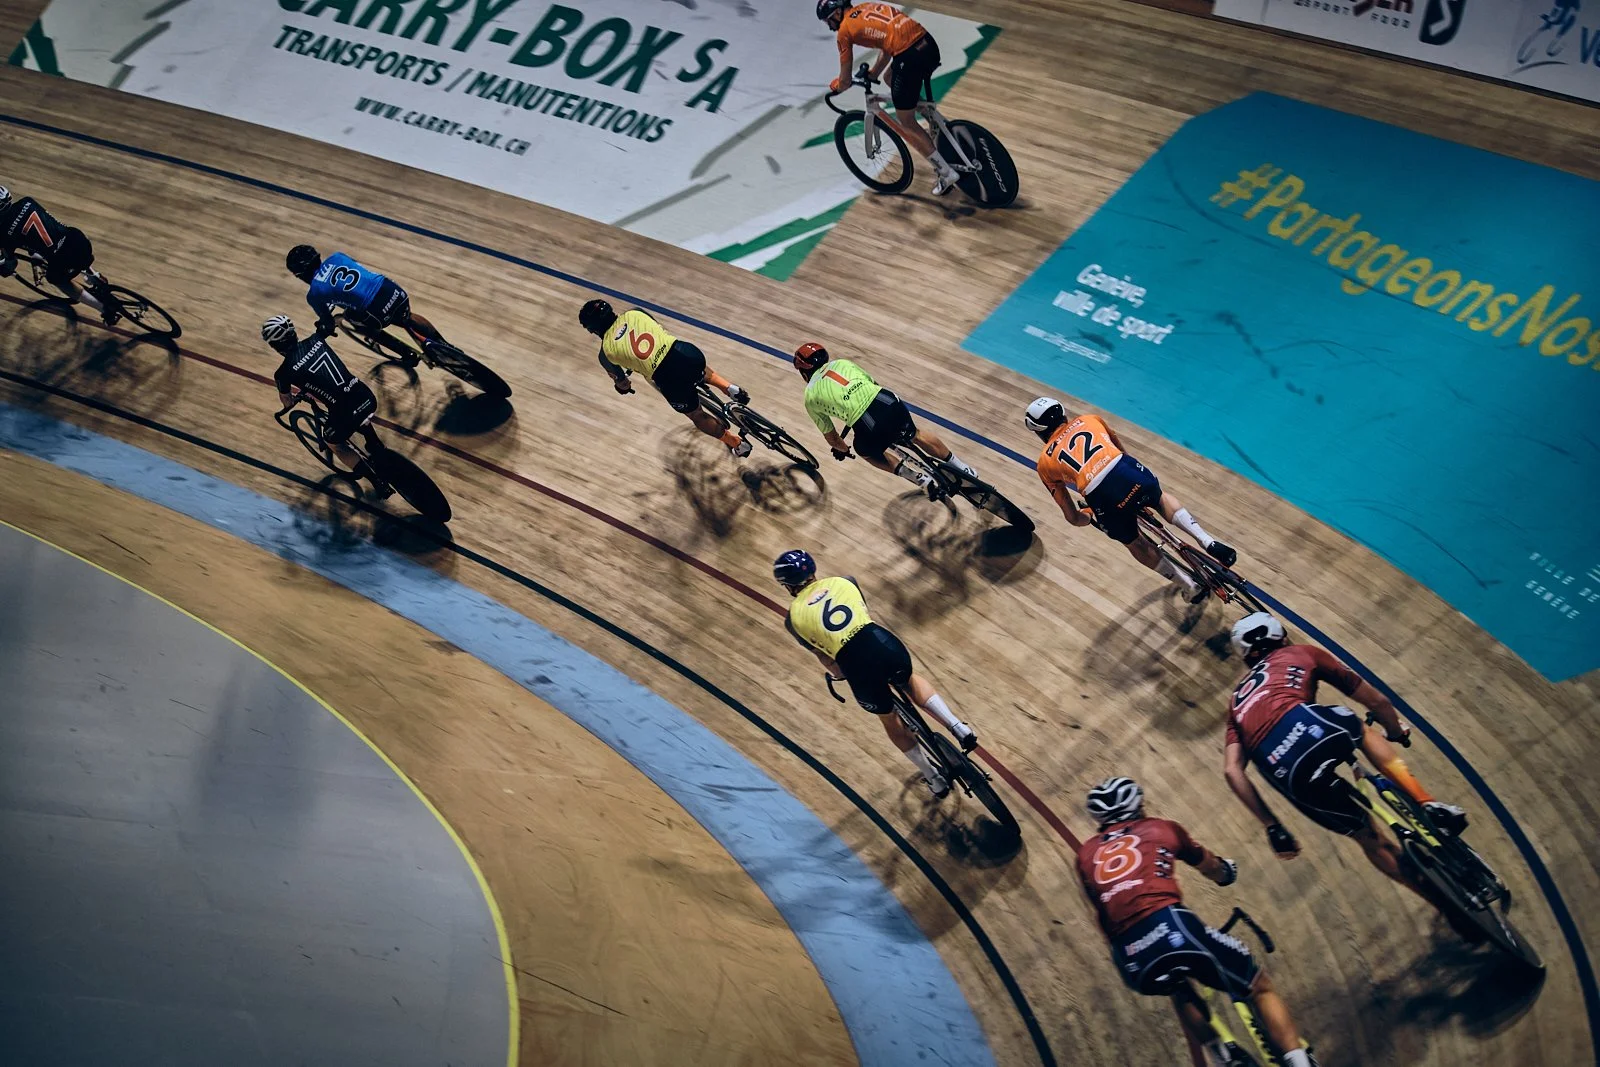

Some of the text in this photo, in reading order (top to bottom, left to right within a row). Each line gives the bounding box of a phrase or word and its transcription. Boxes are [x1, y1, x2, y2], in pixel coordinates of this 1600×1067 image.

[278, 0, 684, 93] RRY-BOX
[273, 25, 450, 86] TRANSPORTS
[464, 70, 674, 143] MANUTENTIONS
[355, 97, 531, 156] WWW.CARRY-BOX.CH
[21, 210, 54, 248] 7
[329, 265, 361, 292] 3
[292, 340, 324, 372] RAIFFEISEN
[628, 328, 656, 361] 6
[308, 351, 346, 387] 7
[821, 369, 850, 387] 1
[304, 382, 337, 405] RAIFFEISEN
[1057, 430, 1104, 473] 12
[821, 597, 854, 633] 6
[1271, 720, 1308, 761] FRANCE
[1092, 833, 1143, 885] 8
